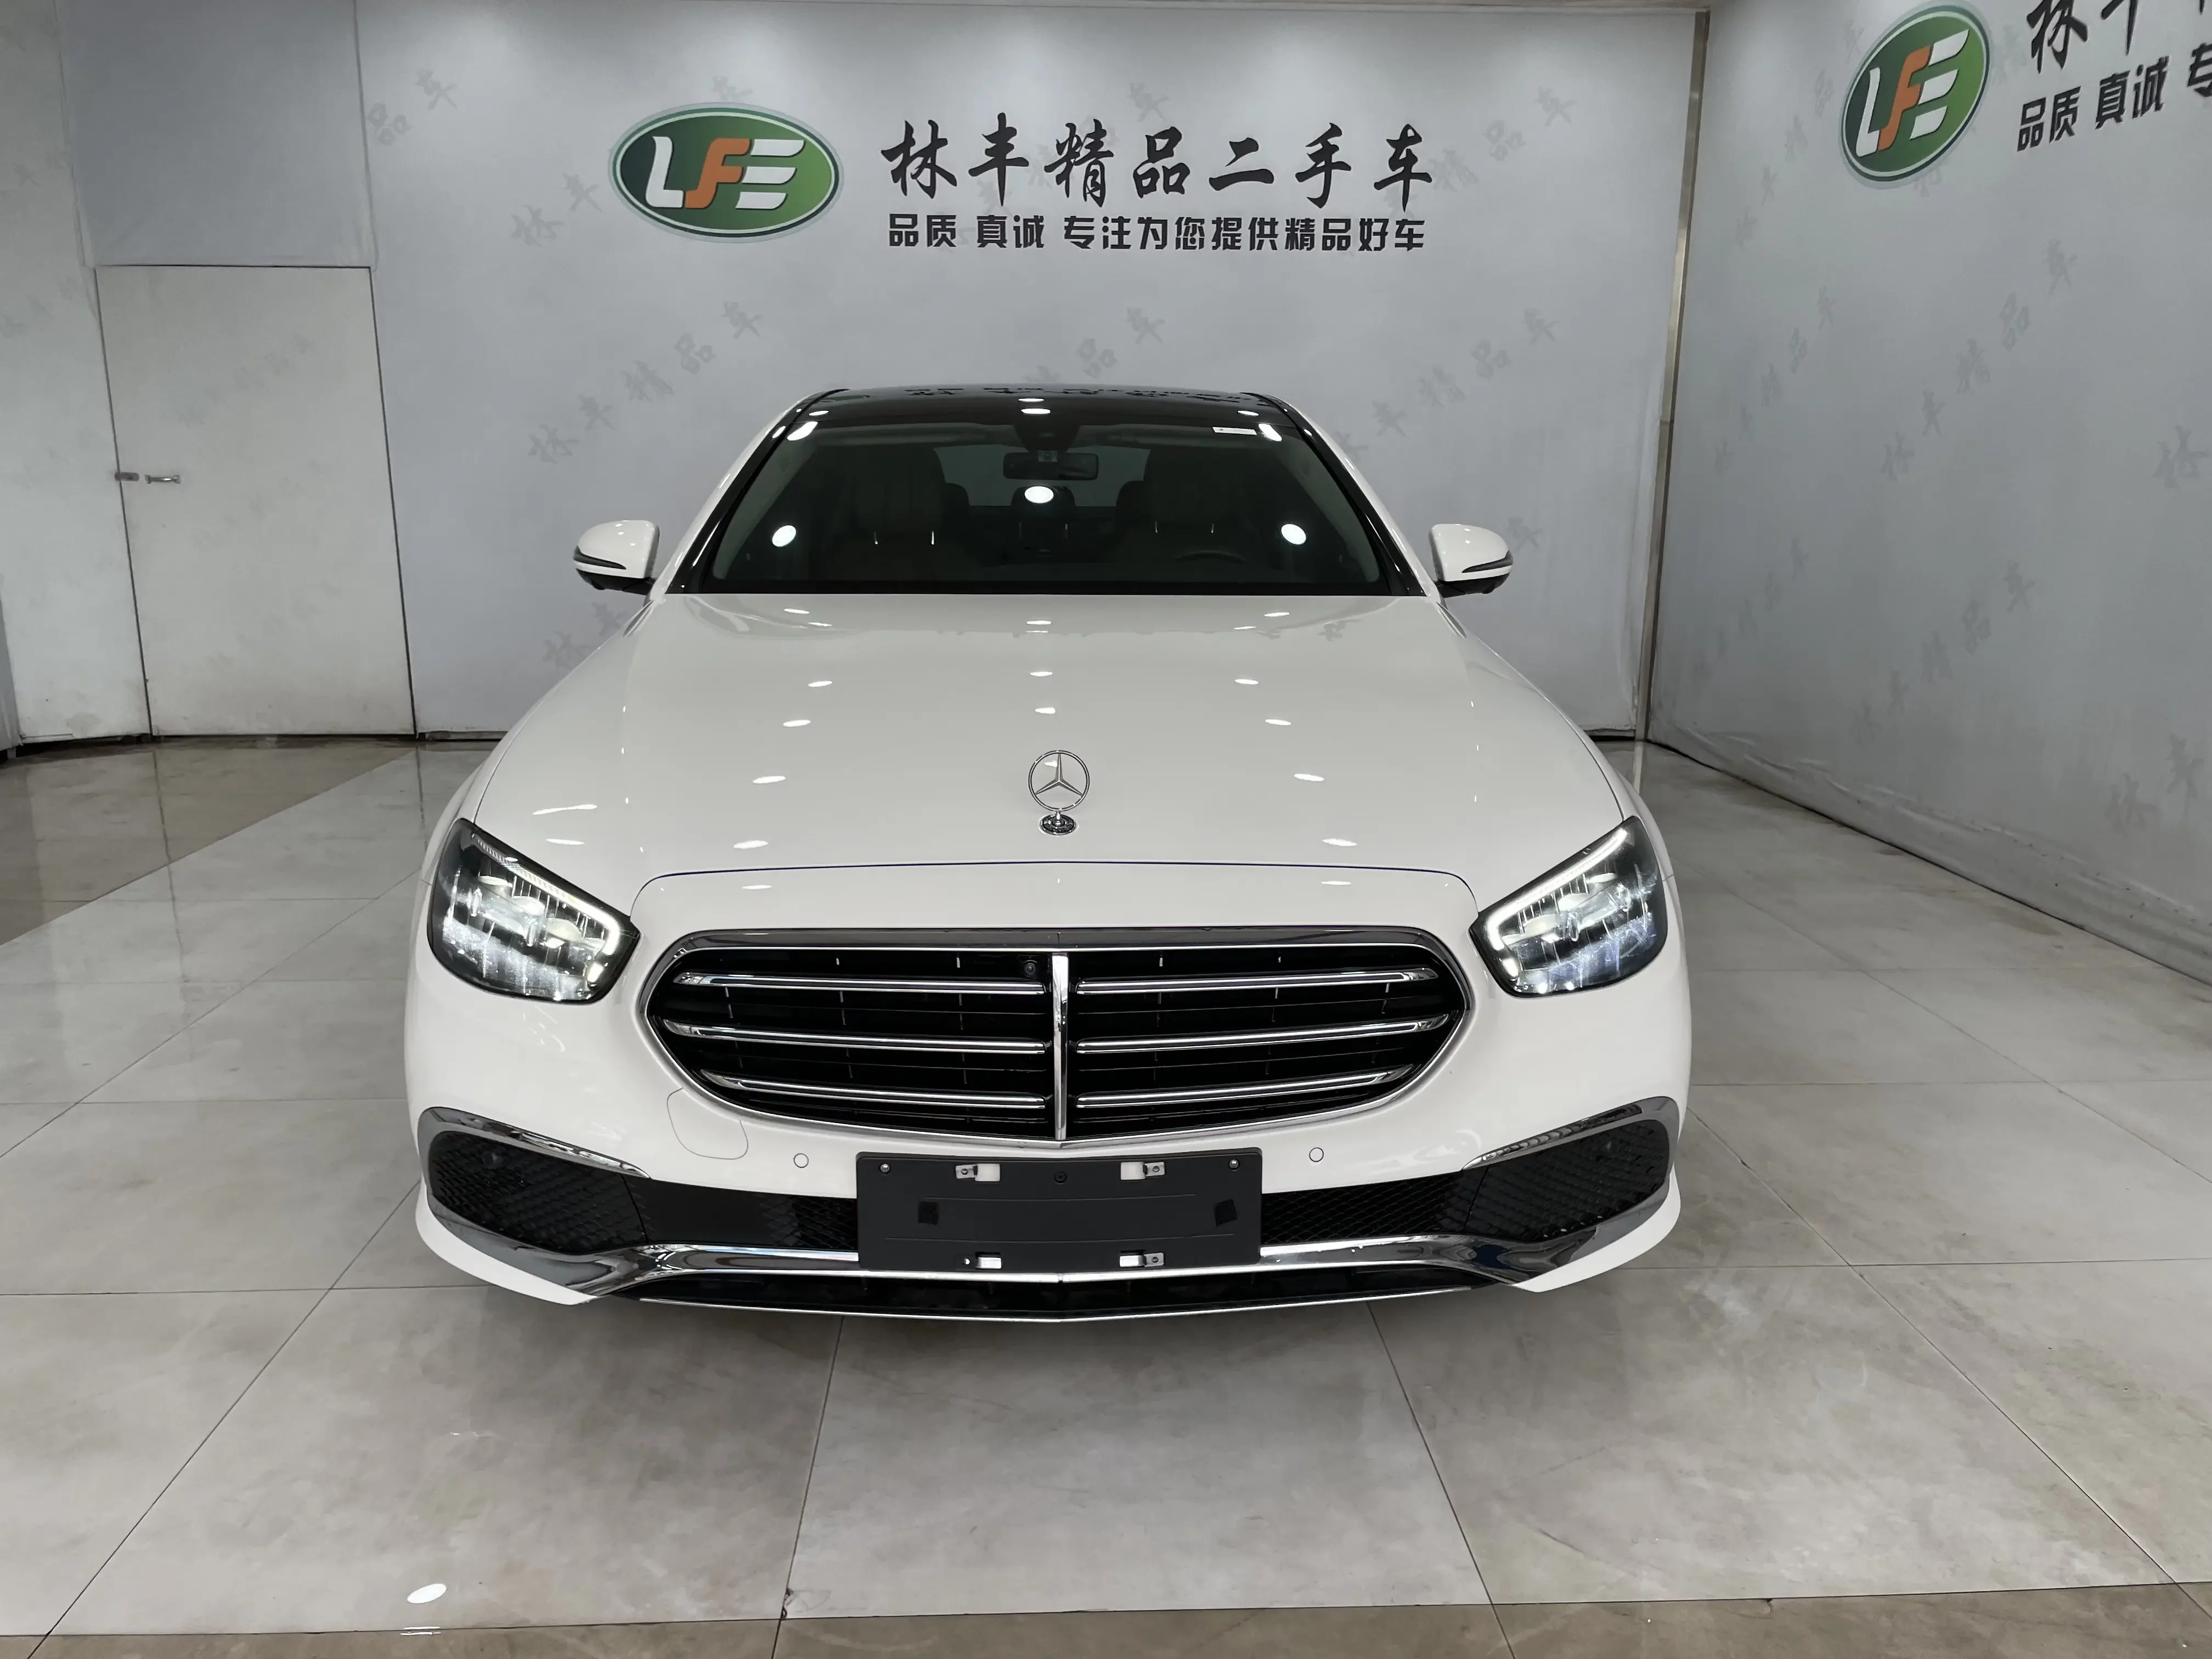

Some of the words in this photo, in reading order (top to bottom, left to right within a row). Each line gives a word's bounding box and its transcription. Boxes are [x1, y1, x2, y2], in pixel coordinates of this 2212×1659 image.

[2017, 86, 2082, 152] 品质
[2095, 55, 2170, 130] 真诚
[881, 112, 1432, 211] 林丰精品二手车
[889, 213, 957, 247] 品质
[977, 215, 1045, 249] 真诚
[1064, 215, 1425, 252] 专注为您提供精品好车
